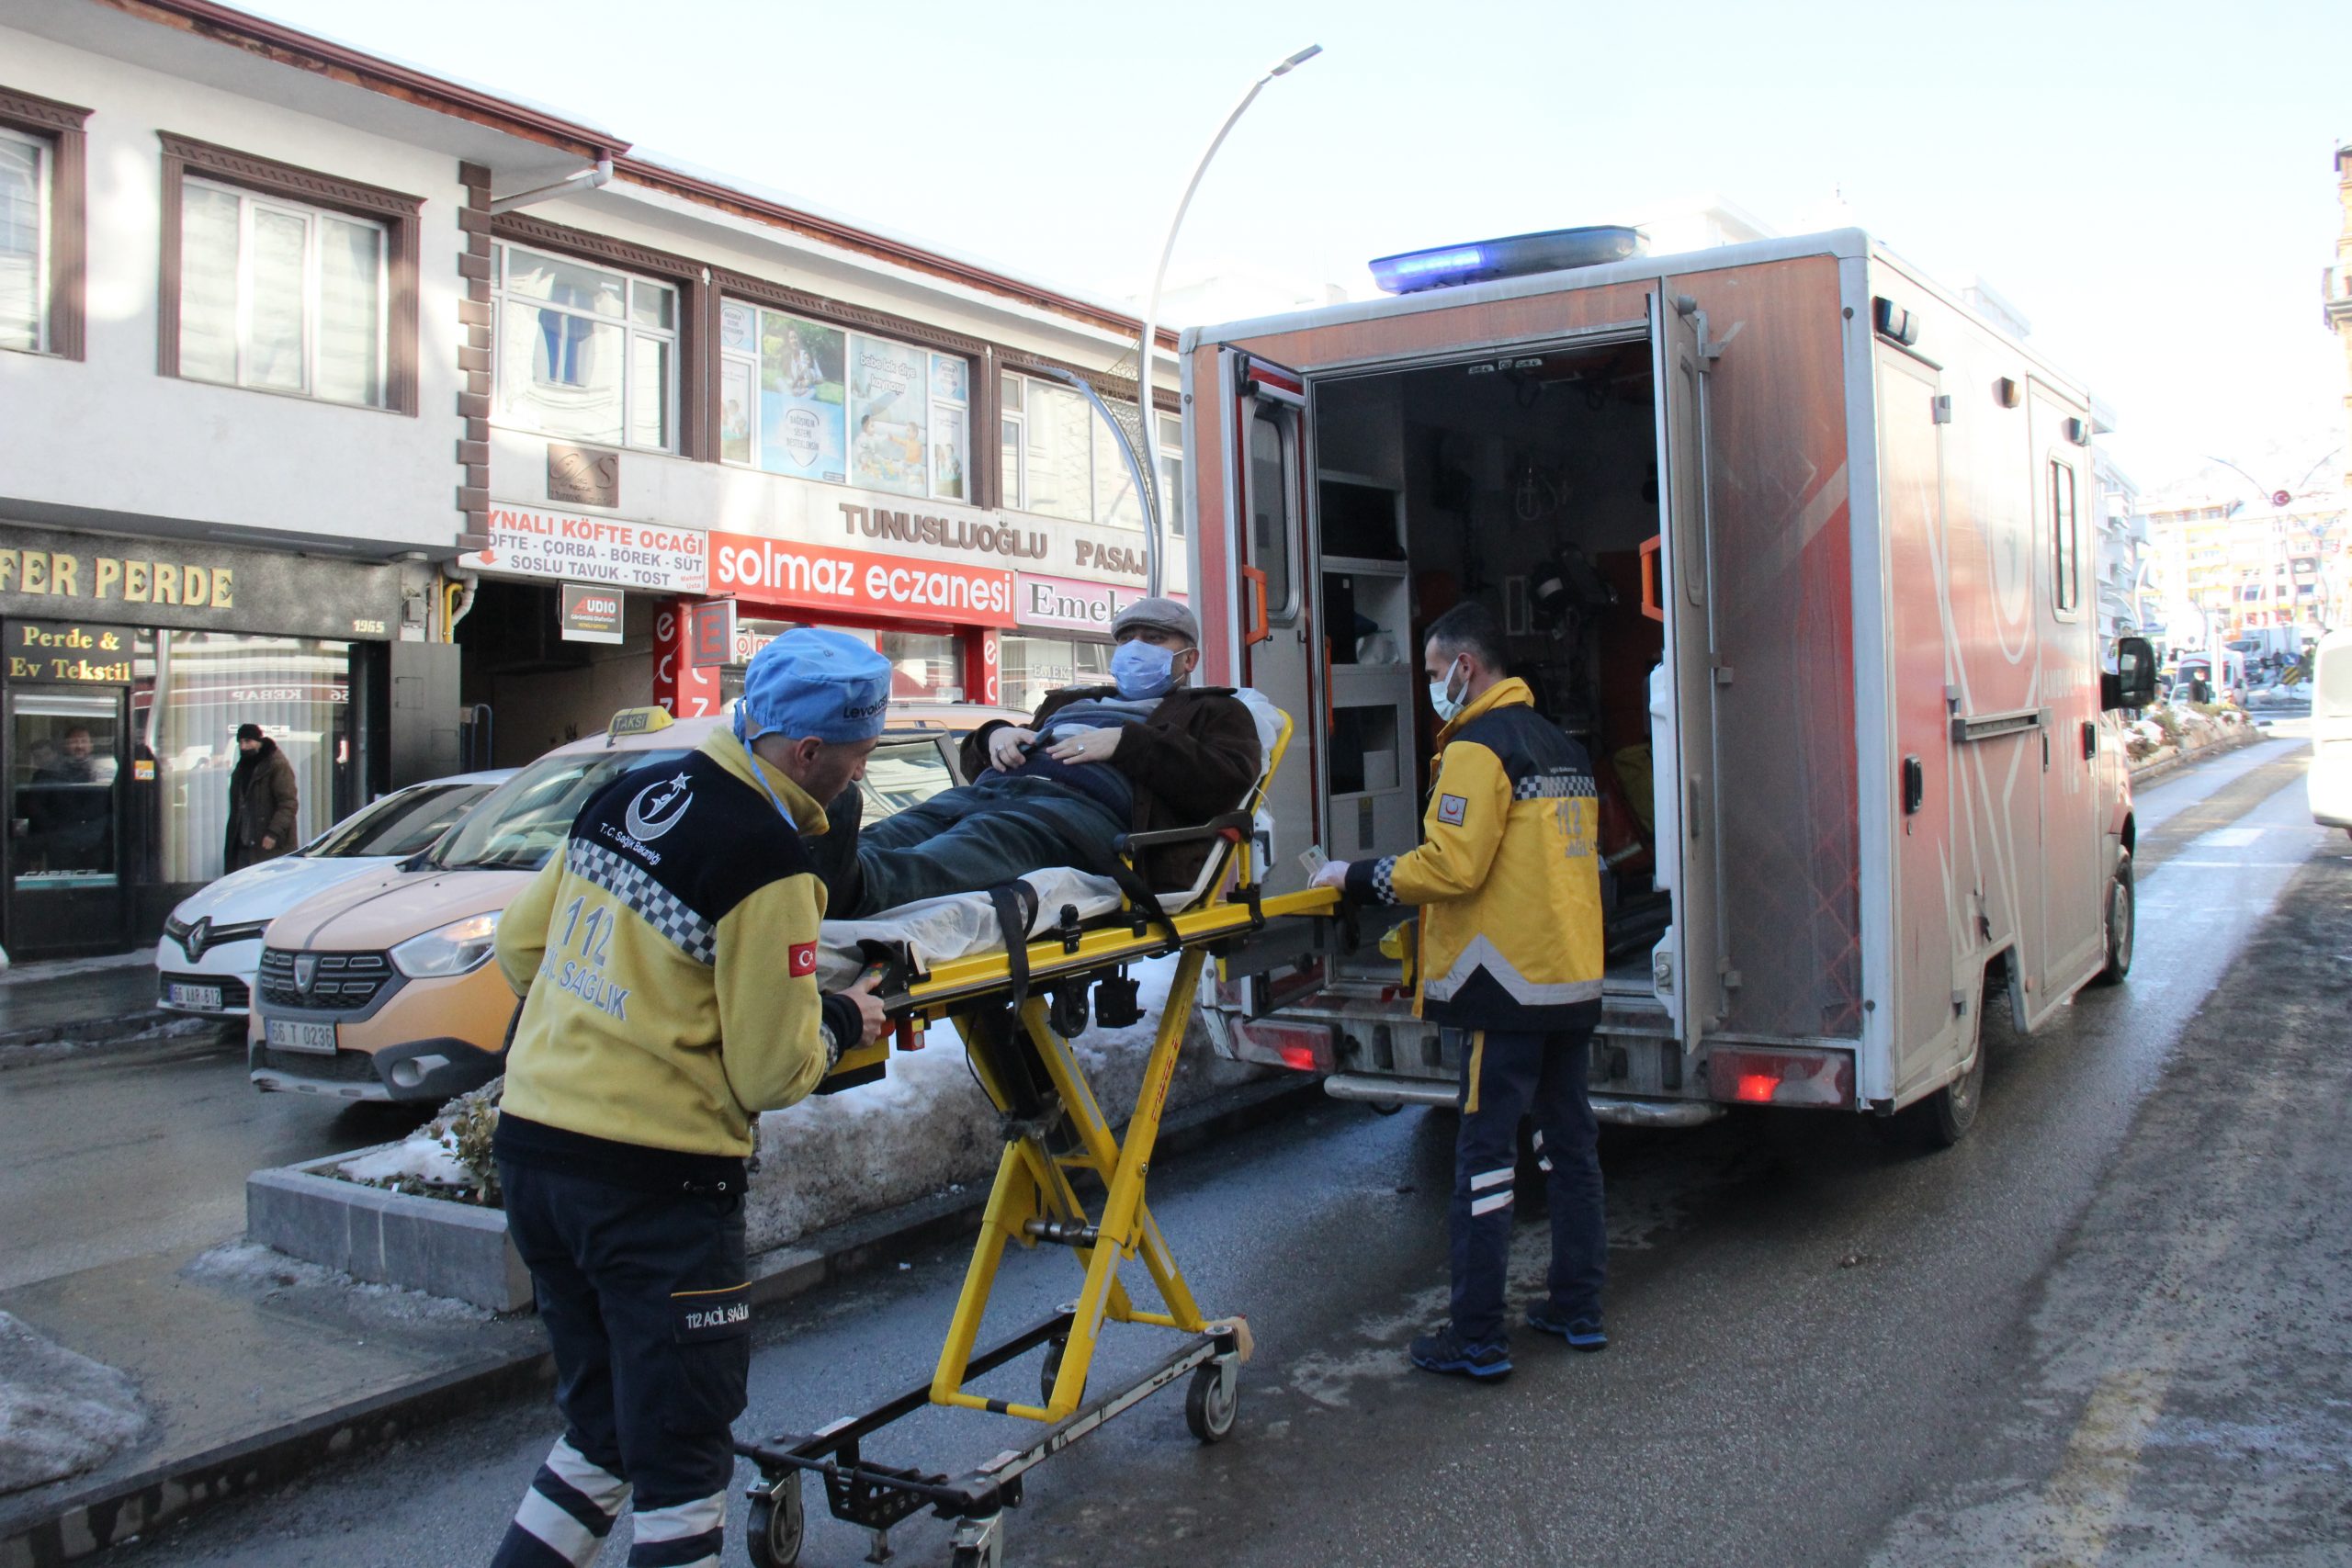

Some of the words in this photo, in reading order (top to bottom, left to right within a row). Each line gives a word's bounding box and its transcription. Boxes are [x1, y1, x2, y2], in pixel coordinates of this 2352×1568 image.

[485, 510, 554, 536] YNALI
[561, 517, 633, 547] KÖFTE
[639, 530, 704, 556] OCAĞI
[838, 502, 1048, 559] TUNUSLUOĞLU
[488, 530, 528, 551] ÖFTE
[543, 539, 596, 559] ÇORBA
[610, 547, 662, 568] BÖREK
[673, 556, 703, 573] SÜT
[95, 558, 233, 609] PERDE
[511, 554, 563, 574] SOSLU
[568, 561, 619, 581] TAVUK
[632, 570, 671, 587] TOST
[718, 541, 855, 596] solmaz
[865, 565, 1011, 613] eczanesi
[1028, 582, 1126, 622] Emek
[23, 626, 93, 649] Perde
[98, 631, 120, 650] &
[353, 619, 386, 634] 1965
[9, 657, 42, 677] Ev
[51, 658, 131, 682] Tekstil
[1034, 664, 1069, 679] EMEK
[599, 822, 616, 838] T.C.
[1555, 800, 1582, 836] 112
[561, 895, 615, 968] 112
[559, 959, 631, 1021] SAĞLIK
[290, 1023, 298, 1044] T
[685, 1312, 703, 1329] 112
[703, 1305, 728, 1327] ACİL
